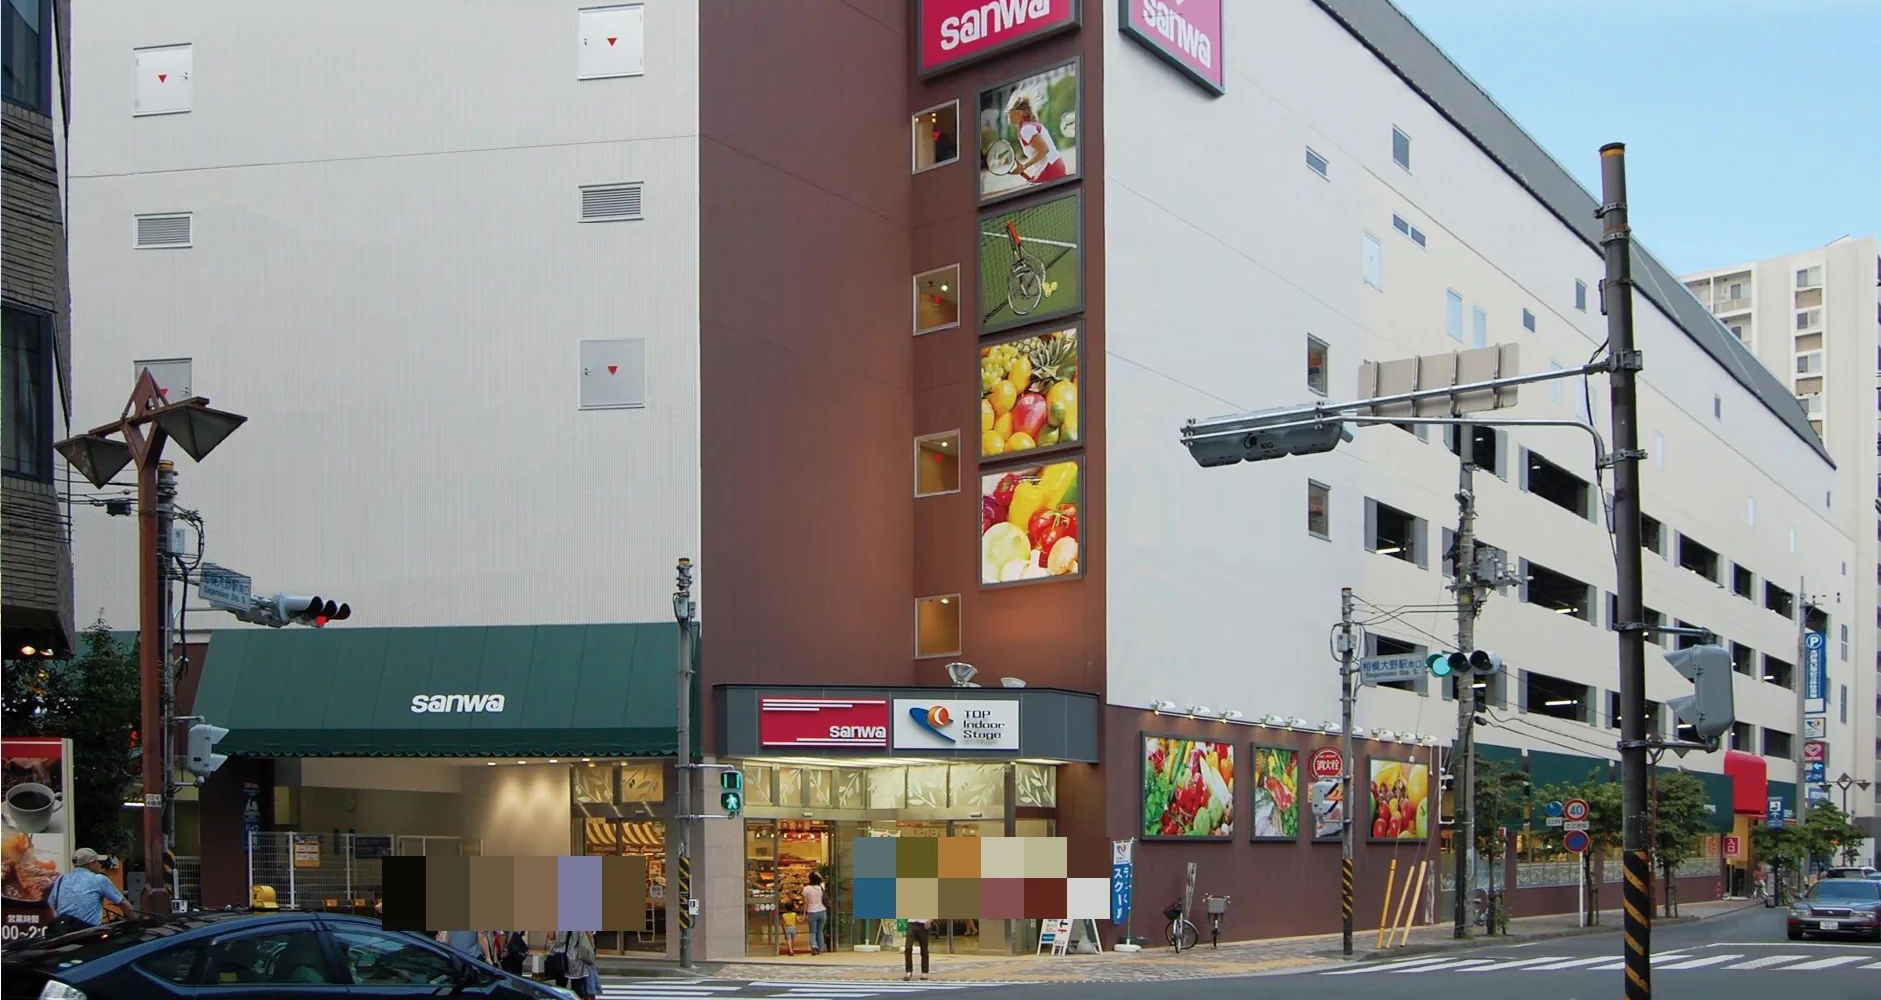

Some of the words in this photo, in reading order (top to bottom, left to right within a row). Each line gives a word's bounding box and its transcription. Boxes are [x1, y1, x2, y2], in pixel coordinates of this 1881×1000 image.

[410, 694, 506, 713] sanwa
[963, 709, 991, 718] TOP
[963, 720, 1005, 728] Indoor
[829, 725, 887, 739] sanwa
[963, 730, 1002, 740] Stage
[1316, 759, 1340, 771] 消火栓
[1570, 804, 1584, 816] 40
[1727, 838, 1736, 853] 入口
